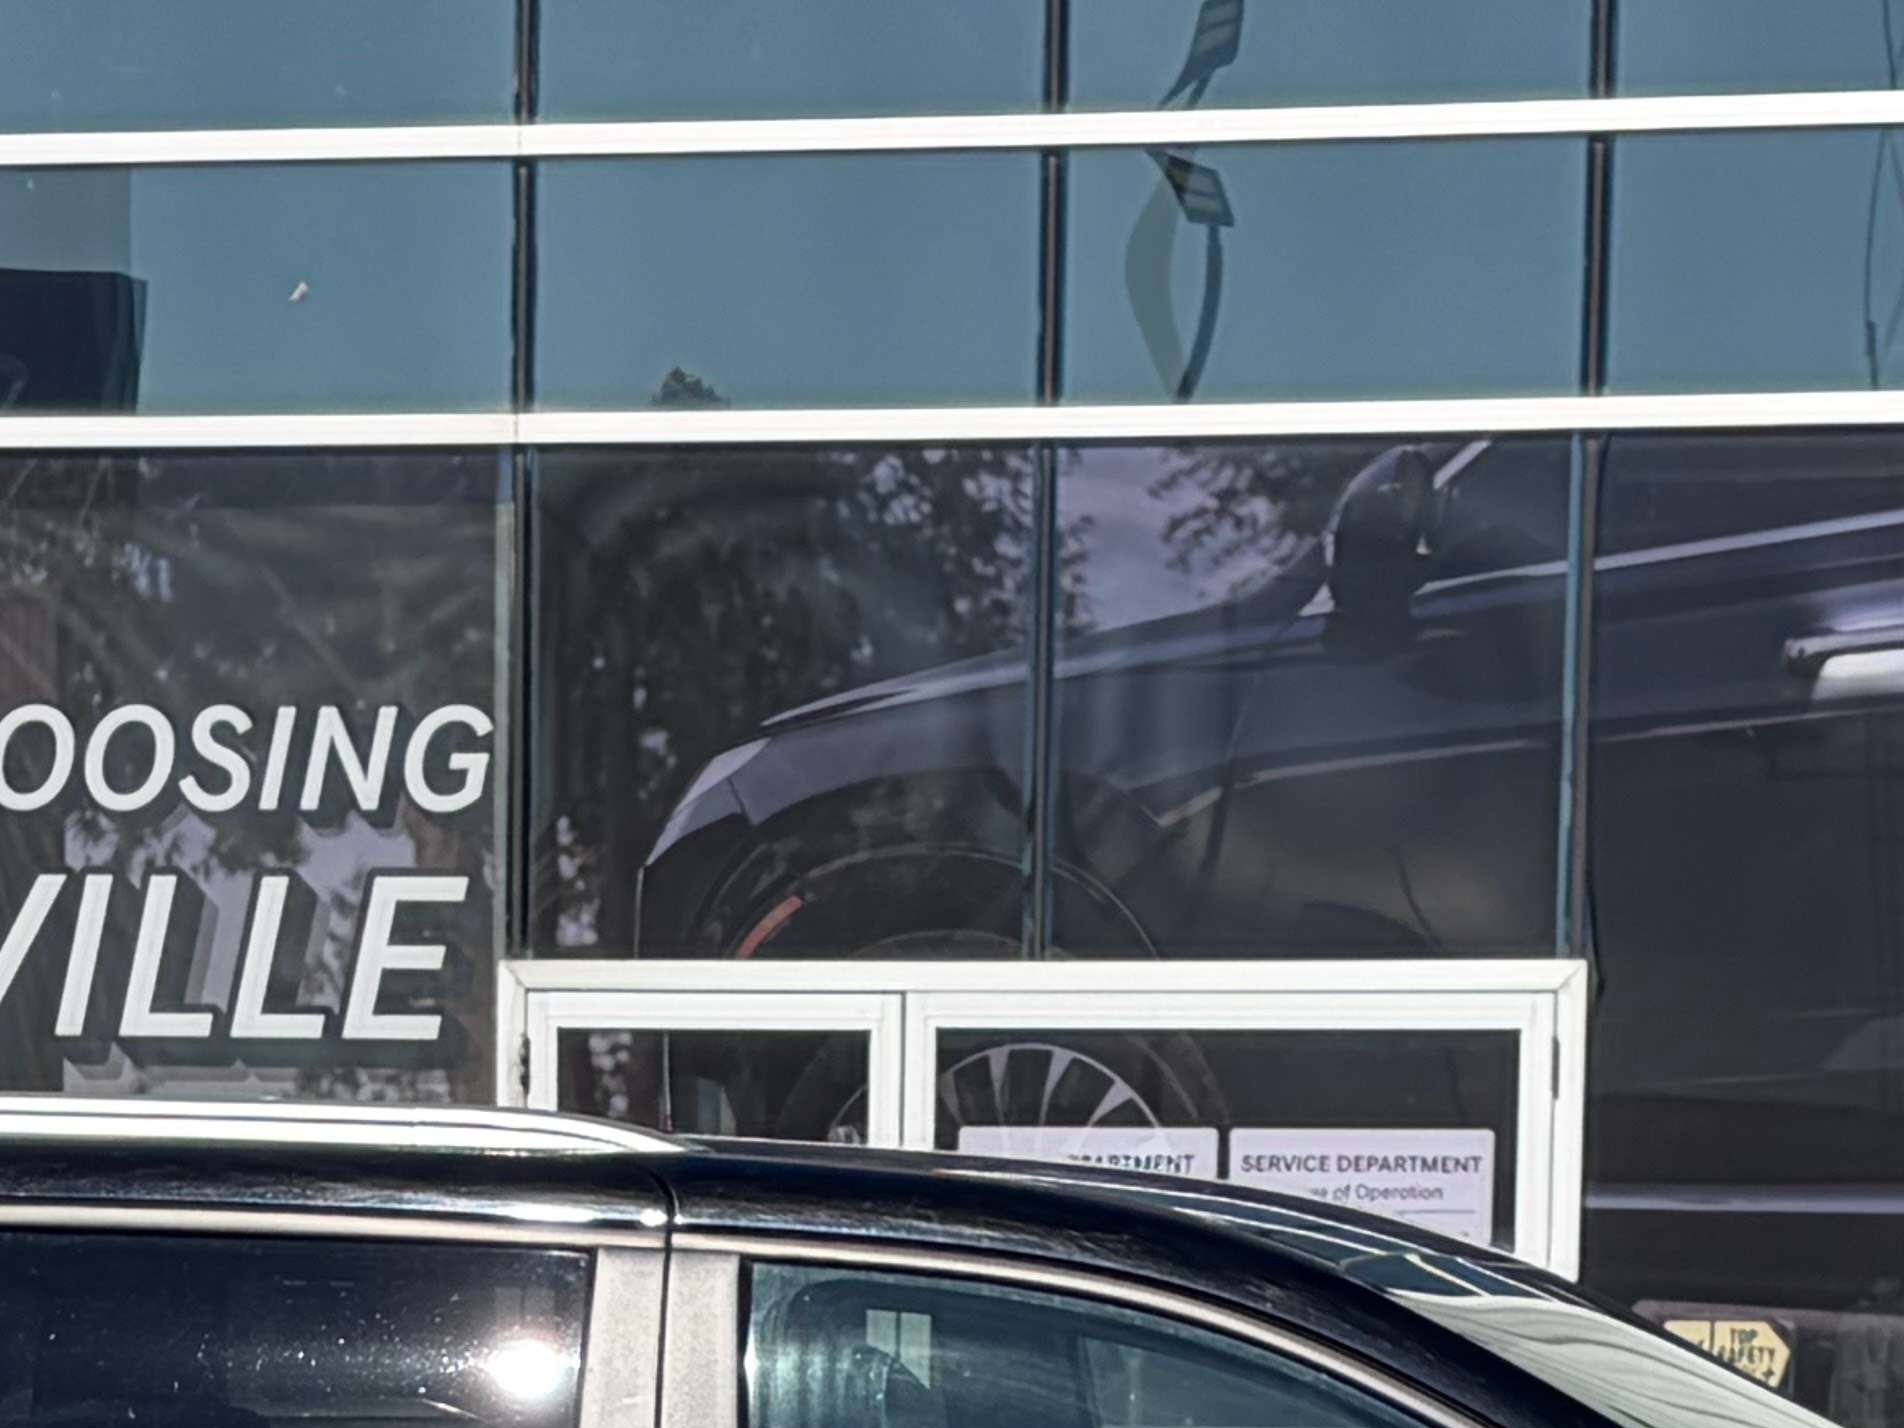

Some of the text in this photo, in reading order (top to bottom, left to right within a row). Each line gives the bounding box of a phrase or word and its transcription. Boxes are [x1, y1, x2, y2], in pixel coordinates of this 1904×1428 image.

[1241, 1155, 1483, 1173] SERVICE DEPARTMENT
[1356, 1184, 1444, 1201] Operation
